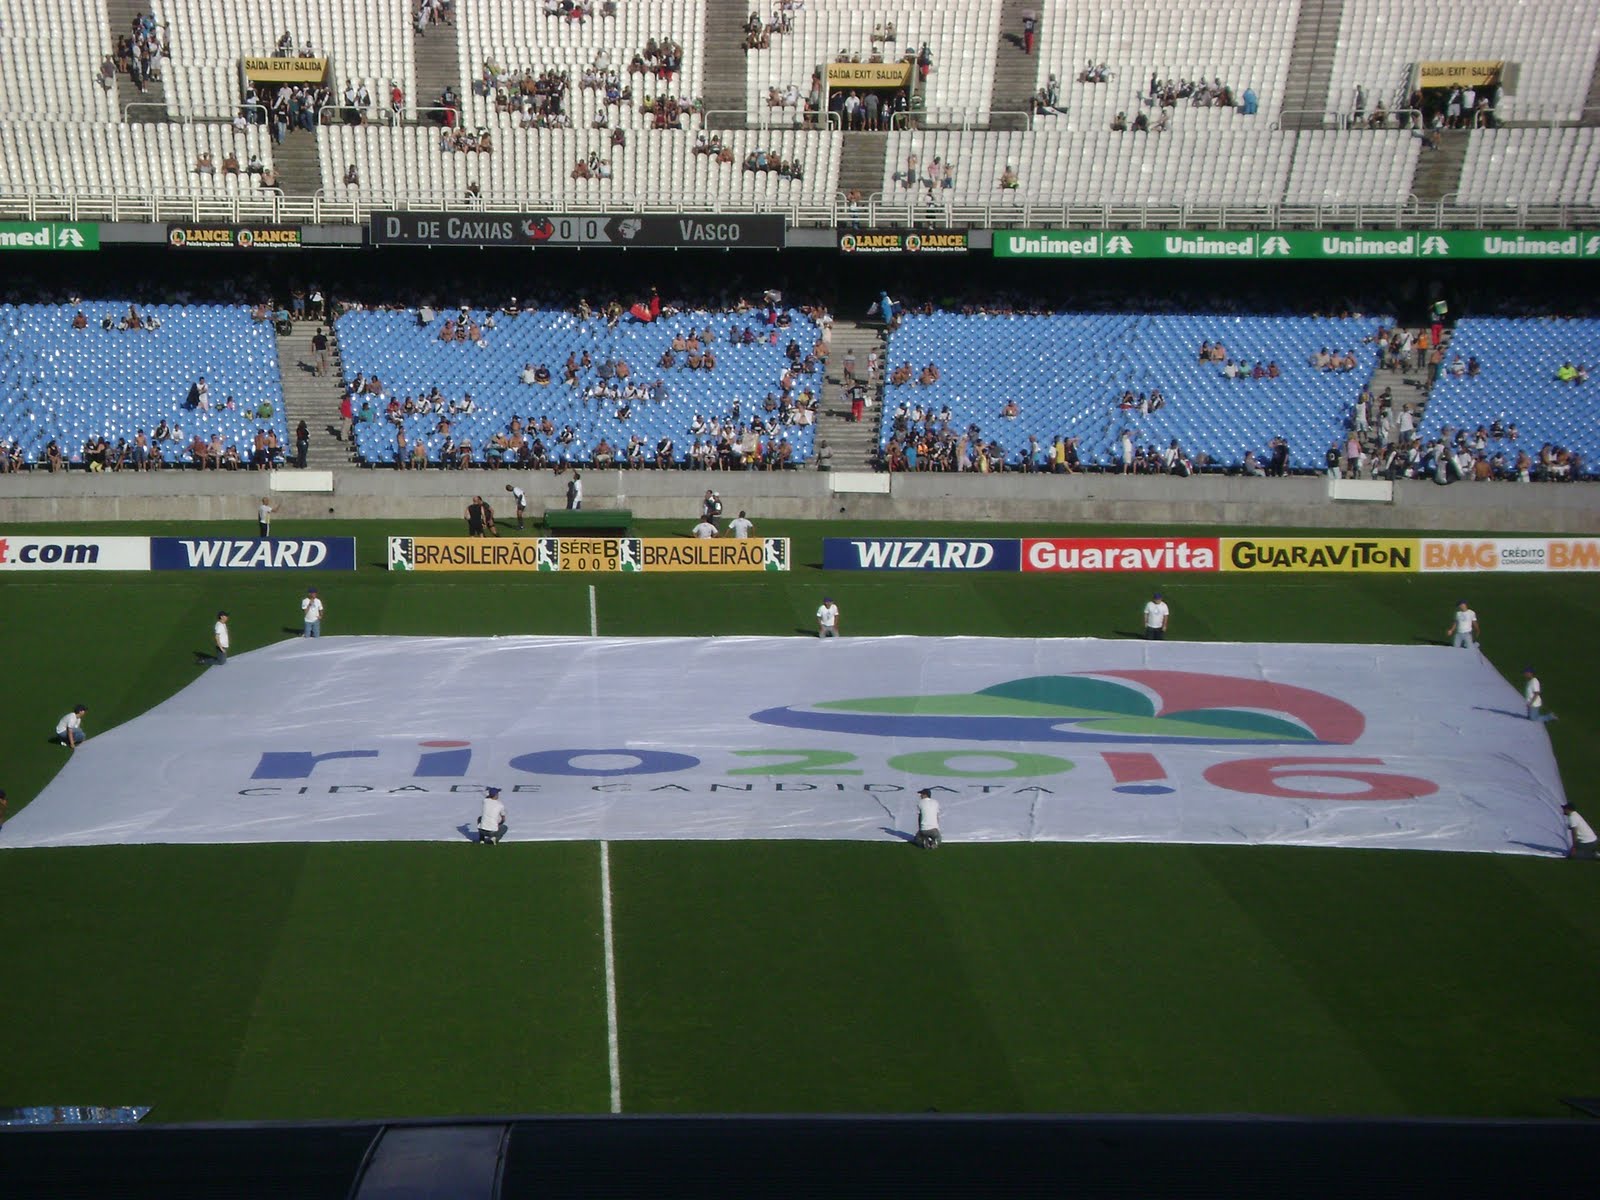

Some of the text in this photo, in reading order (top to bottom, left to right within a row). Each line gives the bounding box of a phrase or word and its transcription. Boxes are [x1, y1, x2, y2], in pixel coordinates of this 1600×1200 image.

[273, 61, 290, 71] EXIT
[294, 61, 322, 71] SALIDA
[854, 69, 871, 79] EXIT
[876, 70, 903, 80] SALIDA
[1448, 67, 1466, 76] EXIT
[417, 221, 440, 239] DE
[560, 220, 572, 239] 0
[586, 220, 598, 240] 0
[1009, 236, 1098, 254] Unimed
[1165, 236, 1254, 255] Unimed
[1322, 236, 1414, 255] Unimed
[1484, 236, 1577, 255] Unimed
[178, 540, 327, 568] WIZARD
[415, 542, 536, 565] BRASILEIRÃO
[643, 542, 763, 565] BRASILEIRÃO
[851, 541, 994, 568] WIZARD
[1029, 541, 1214, 568] Guaravita
[1424, 542, 1498, 569] BMG
[1502, 547, 1545, 558] CRÉDITO
[238, 782, 1055, 796] CIDADE CANDIDATA
